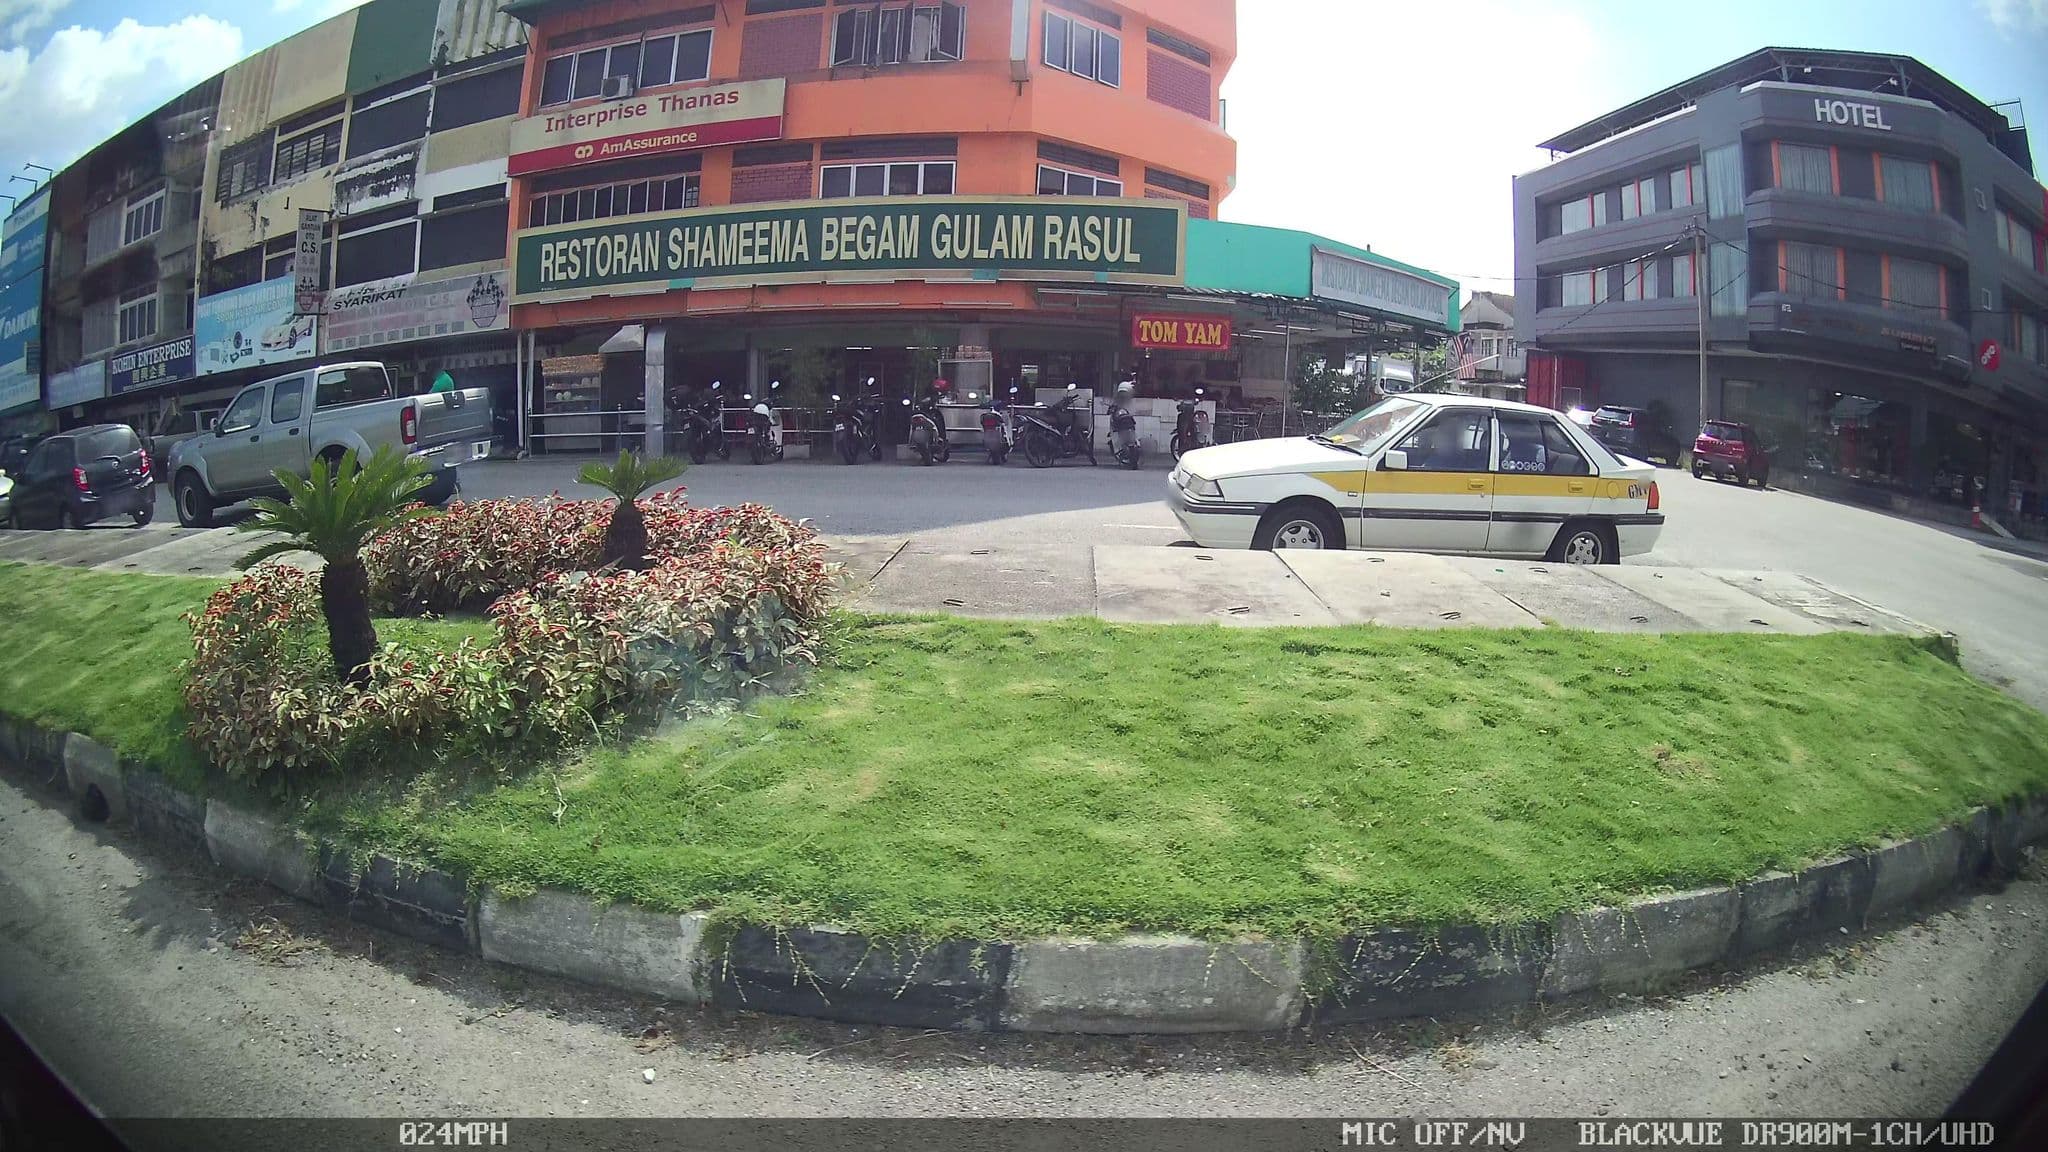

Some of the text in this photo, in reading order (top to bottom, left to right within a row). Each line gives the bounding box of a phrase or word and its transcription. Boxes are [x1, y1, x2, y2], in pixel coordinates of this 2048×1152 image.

[545, 88, 739, 132] Interprise Thanas
[1814, 98, 1892, 131] HOTEL
[600, 131, 697, 155] AmAssurance
[540, 213, 1141, 283] RESTORAN SHAMEEMA BEGAM GULAM RASUL
[333, 288, 407, 310] SYARIKAT
[1139, 319, 1222, 346] TOM YAM
[137, 339, 192, 368] ENTERPRISE
